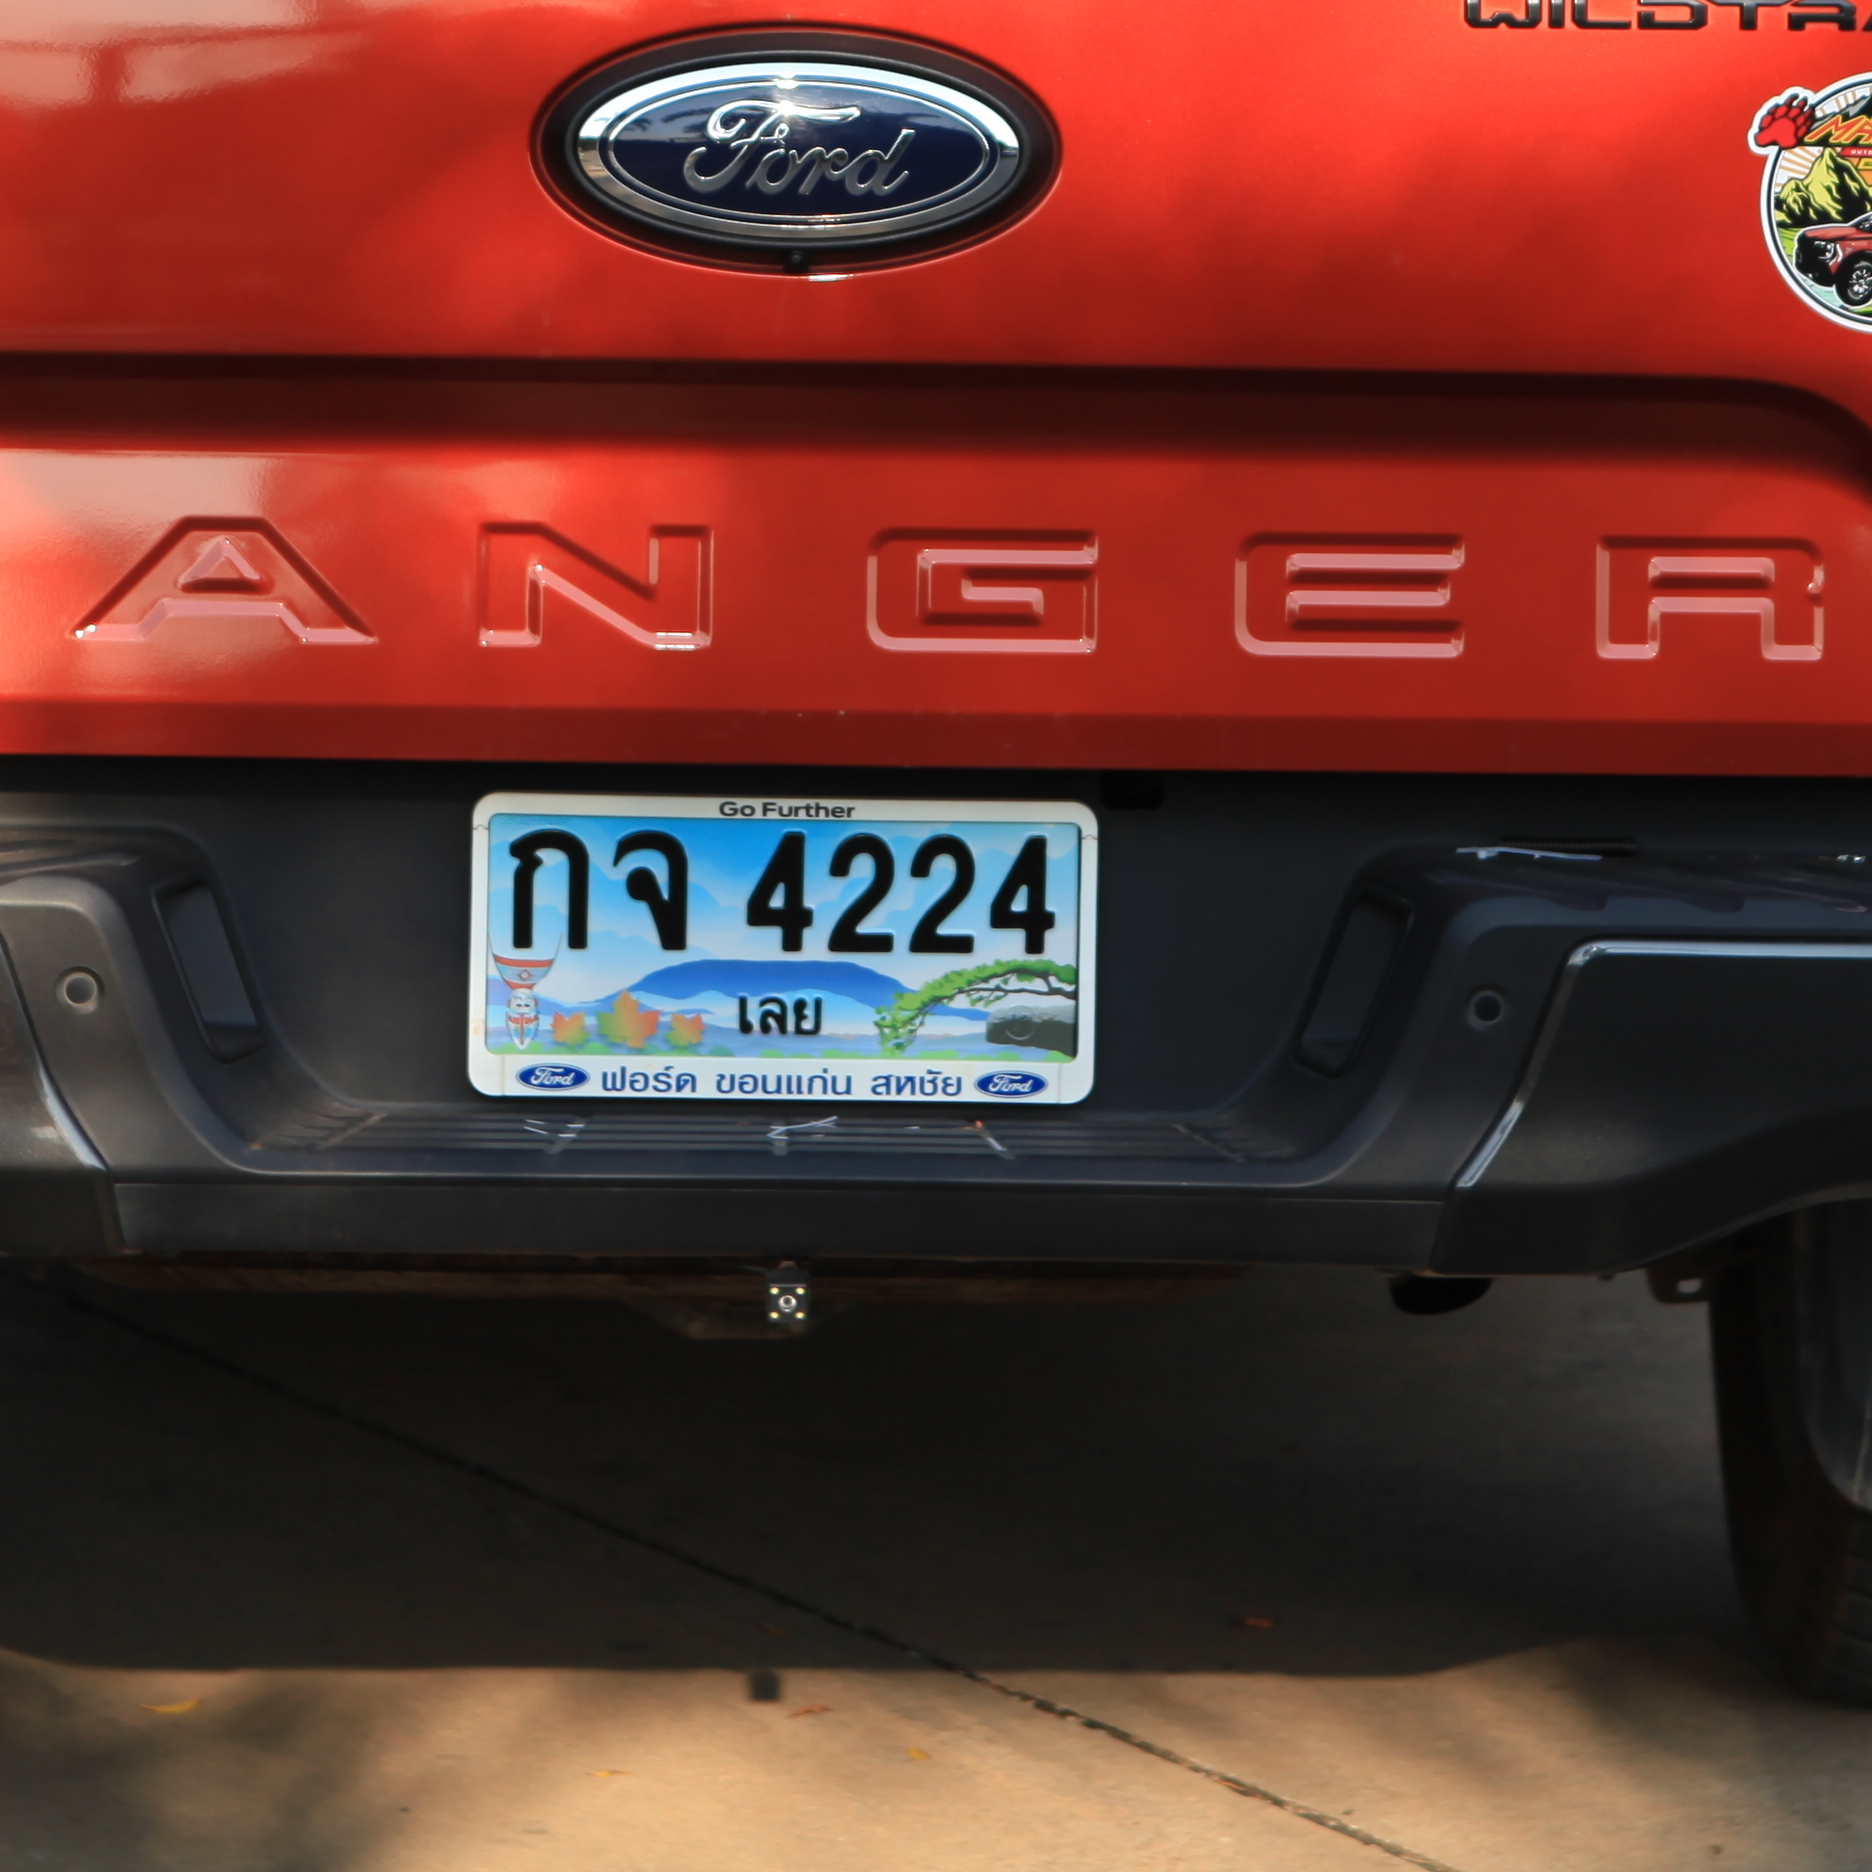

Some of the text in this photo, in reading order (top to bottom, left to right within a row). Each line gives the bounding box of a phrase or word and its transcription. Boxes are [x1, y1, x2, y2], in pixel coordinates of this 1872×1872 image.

[683, 99, 916, 196] Ford
[719, 801, 855, 818] Go Further
[509, 828, 1056, 955] กจ 4224
[736, 992, 824, 1036] เลย
[601, 1065, 697, 1093] ฟอร์ด
[716, 1067, 852, 1095] ขอนแก่น
[870, 1069, 962, 1096] สหชัย
